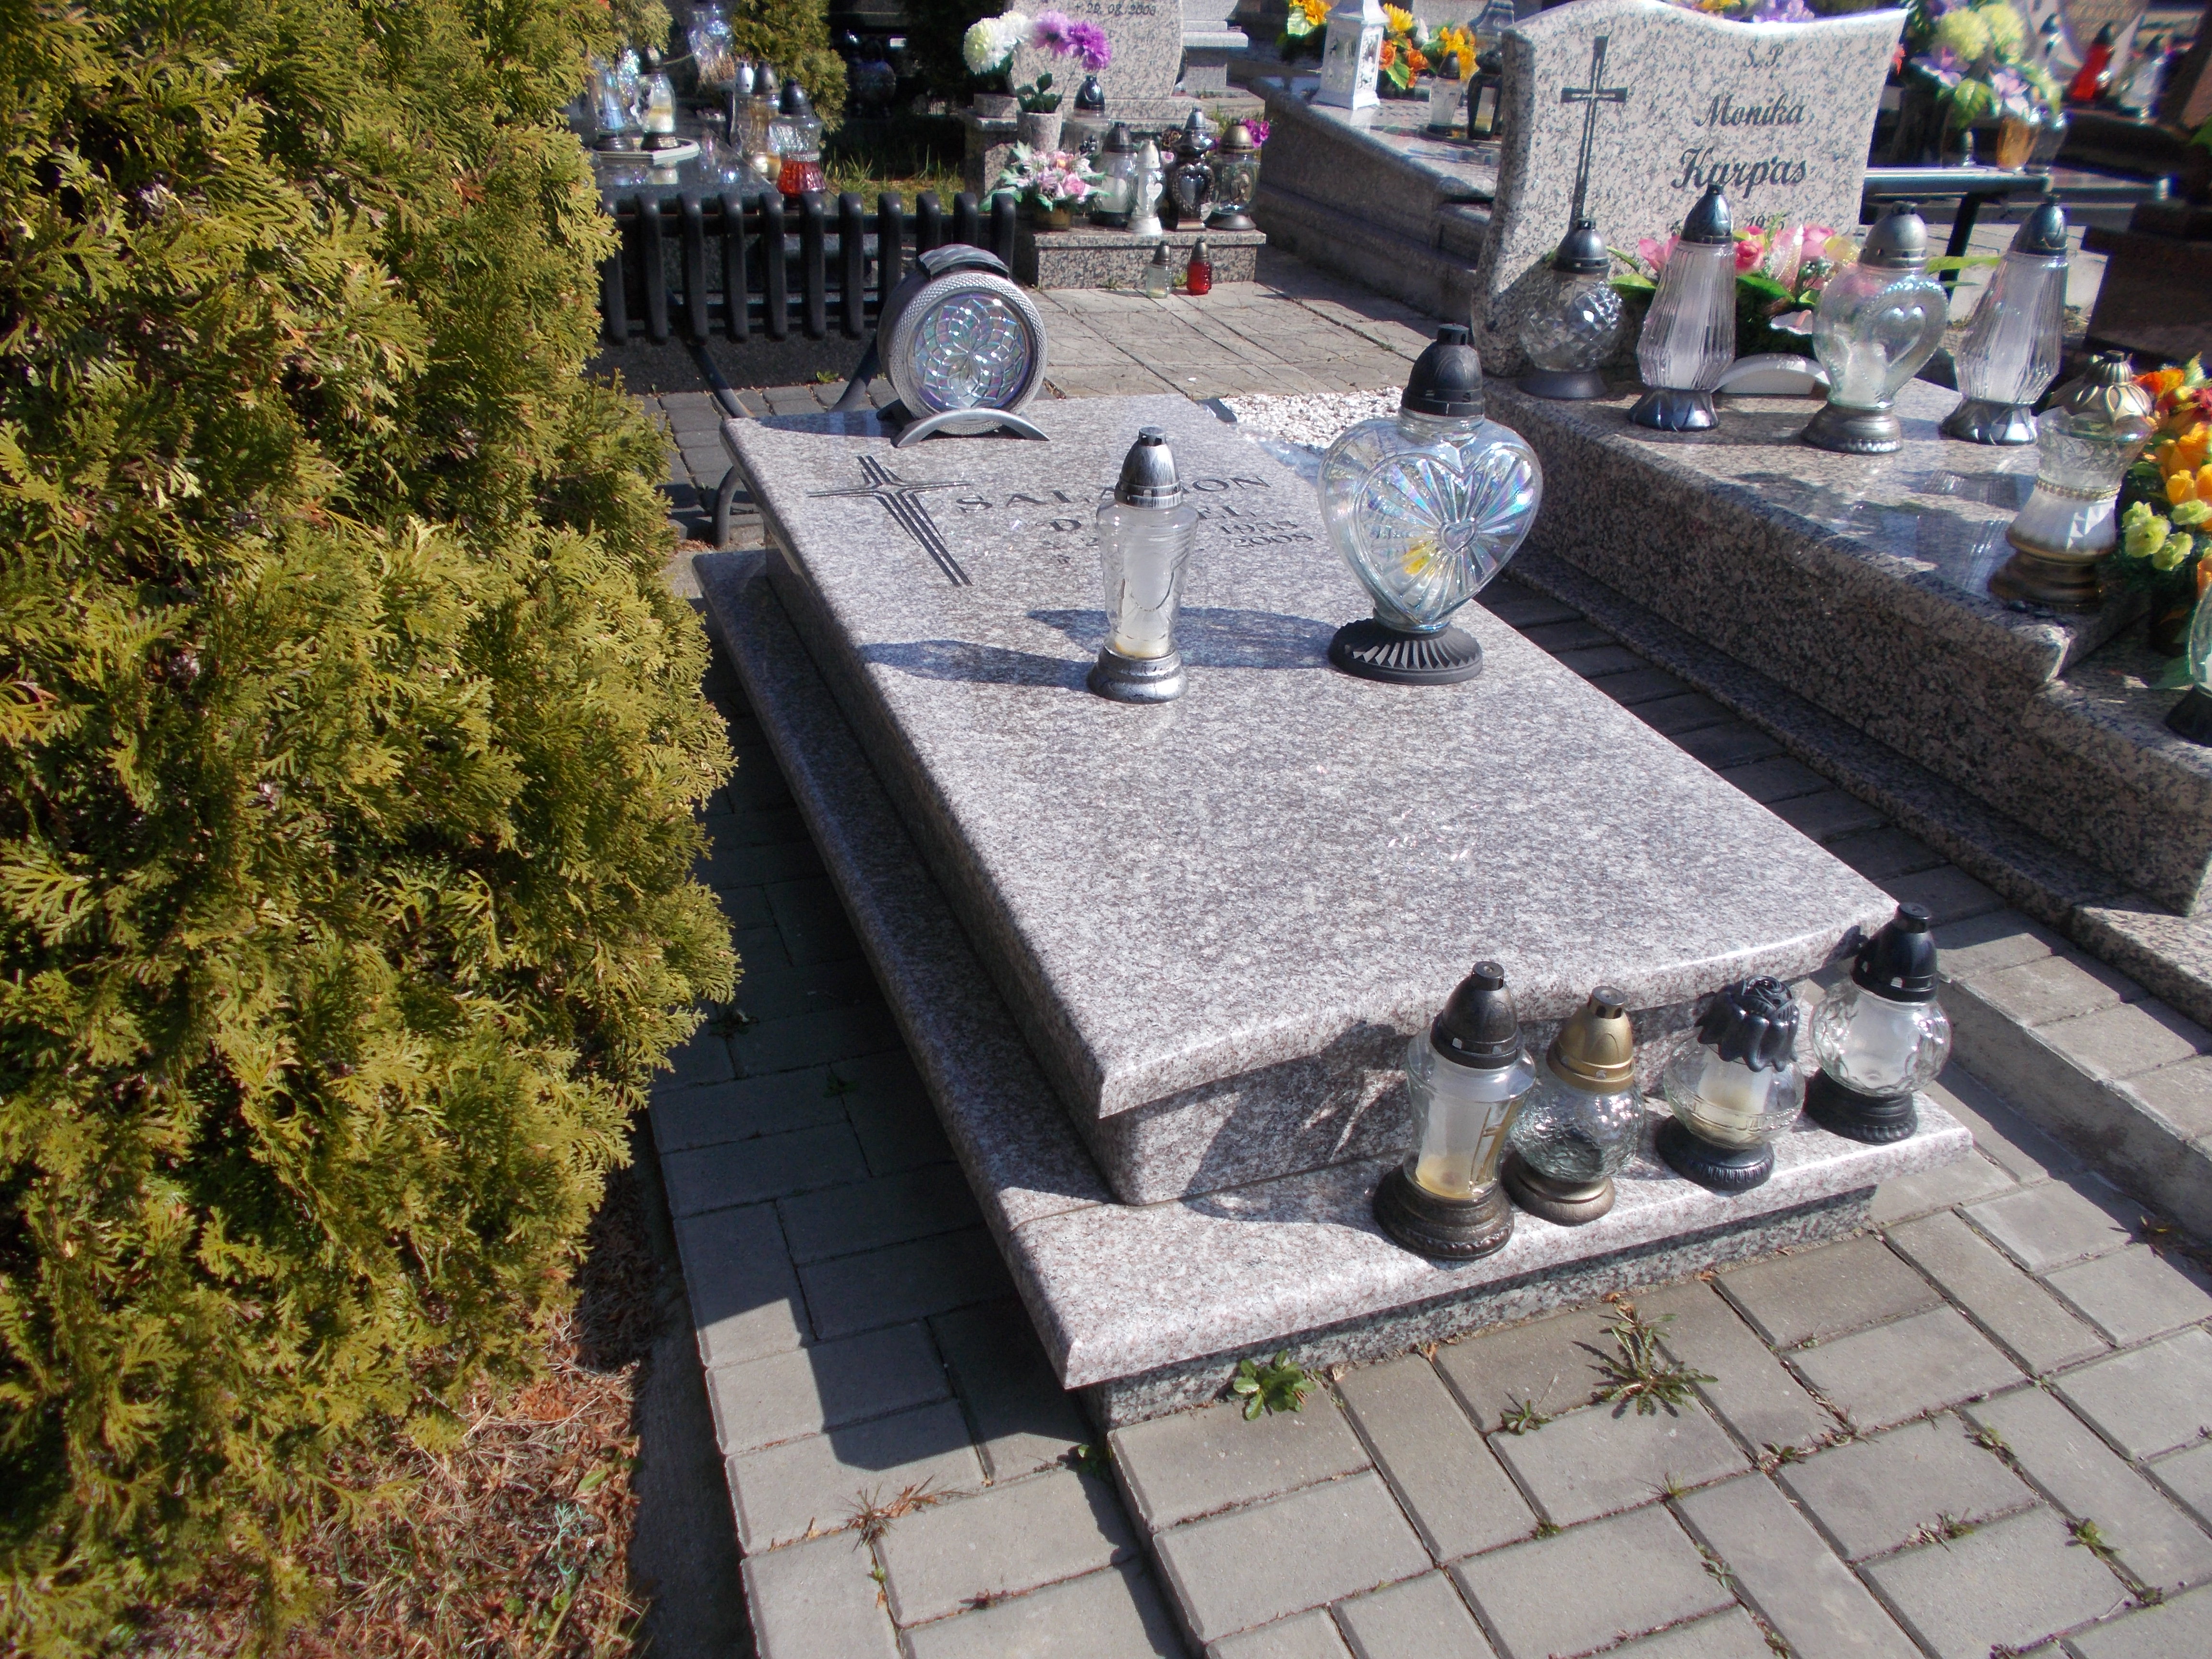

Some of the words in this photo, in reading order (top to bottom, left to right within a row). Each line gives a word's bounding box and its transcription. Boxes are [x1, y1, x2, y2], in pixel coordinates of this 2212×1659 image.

[1693, 93, 1805, 127] Monika
[1671, 145, 1806, 199] Kurpas
[1227, 533, 1313, 548] 2008
